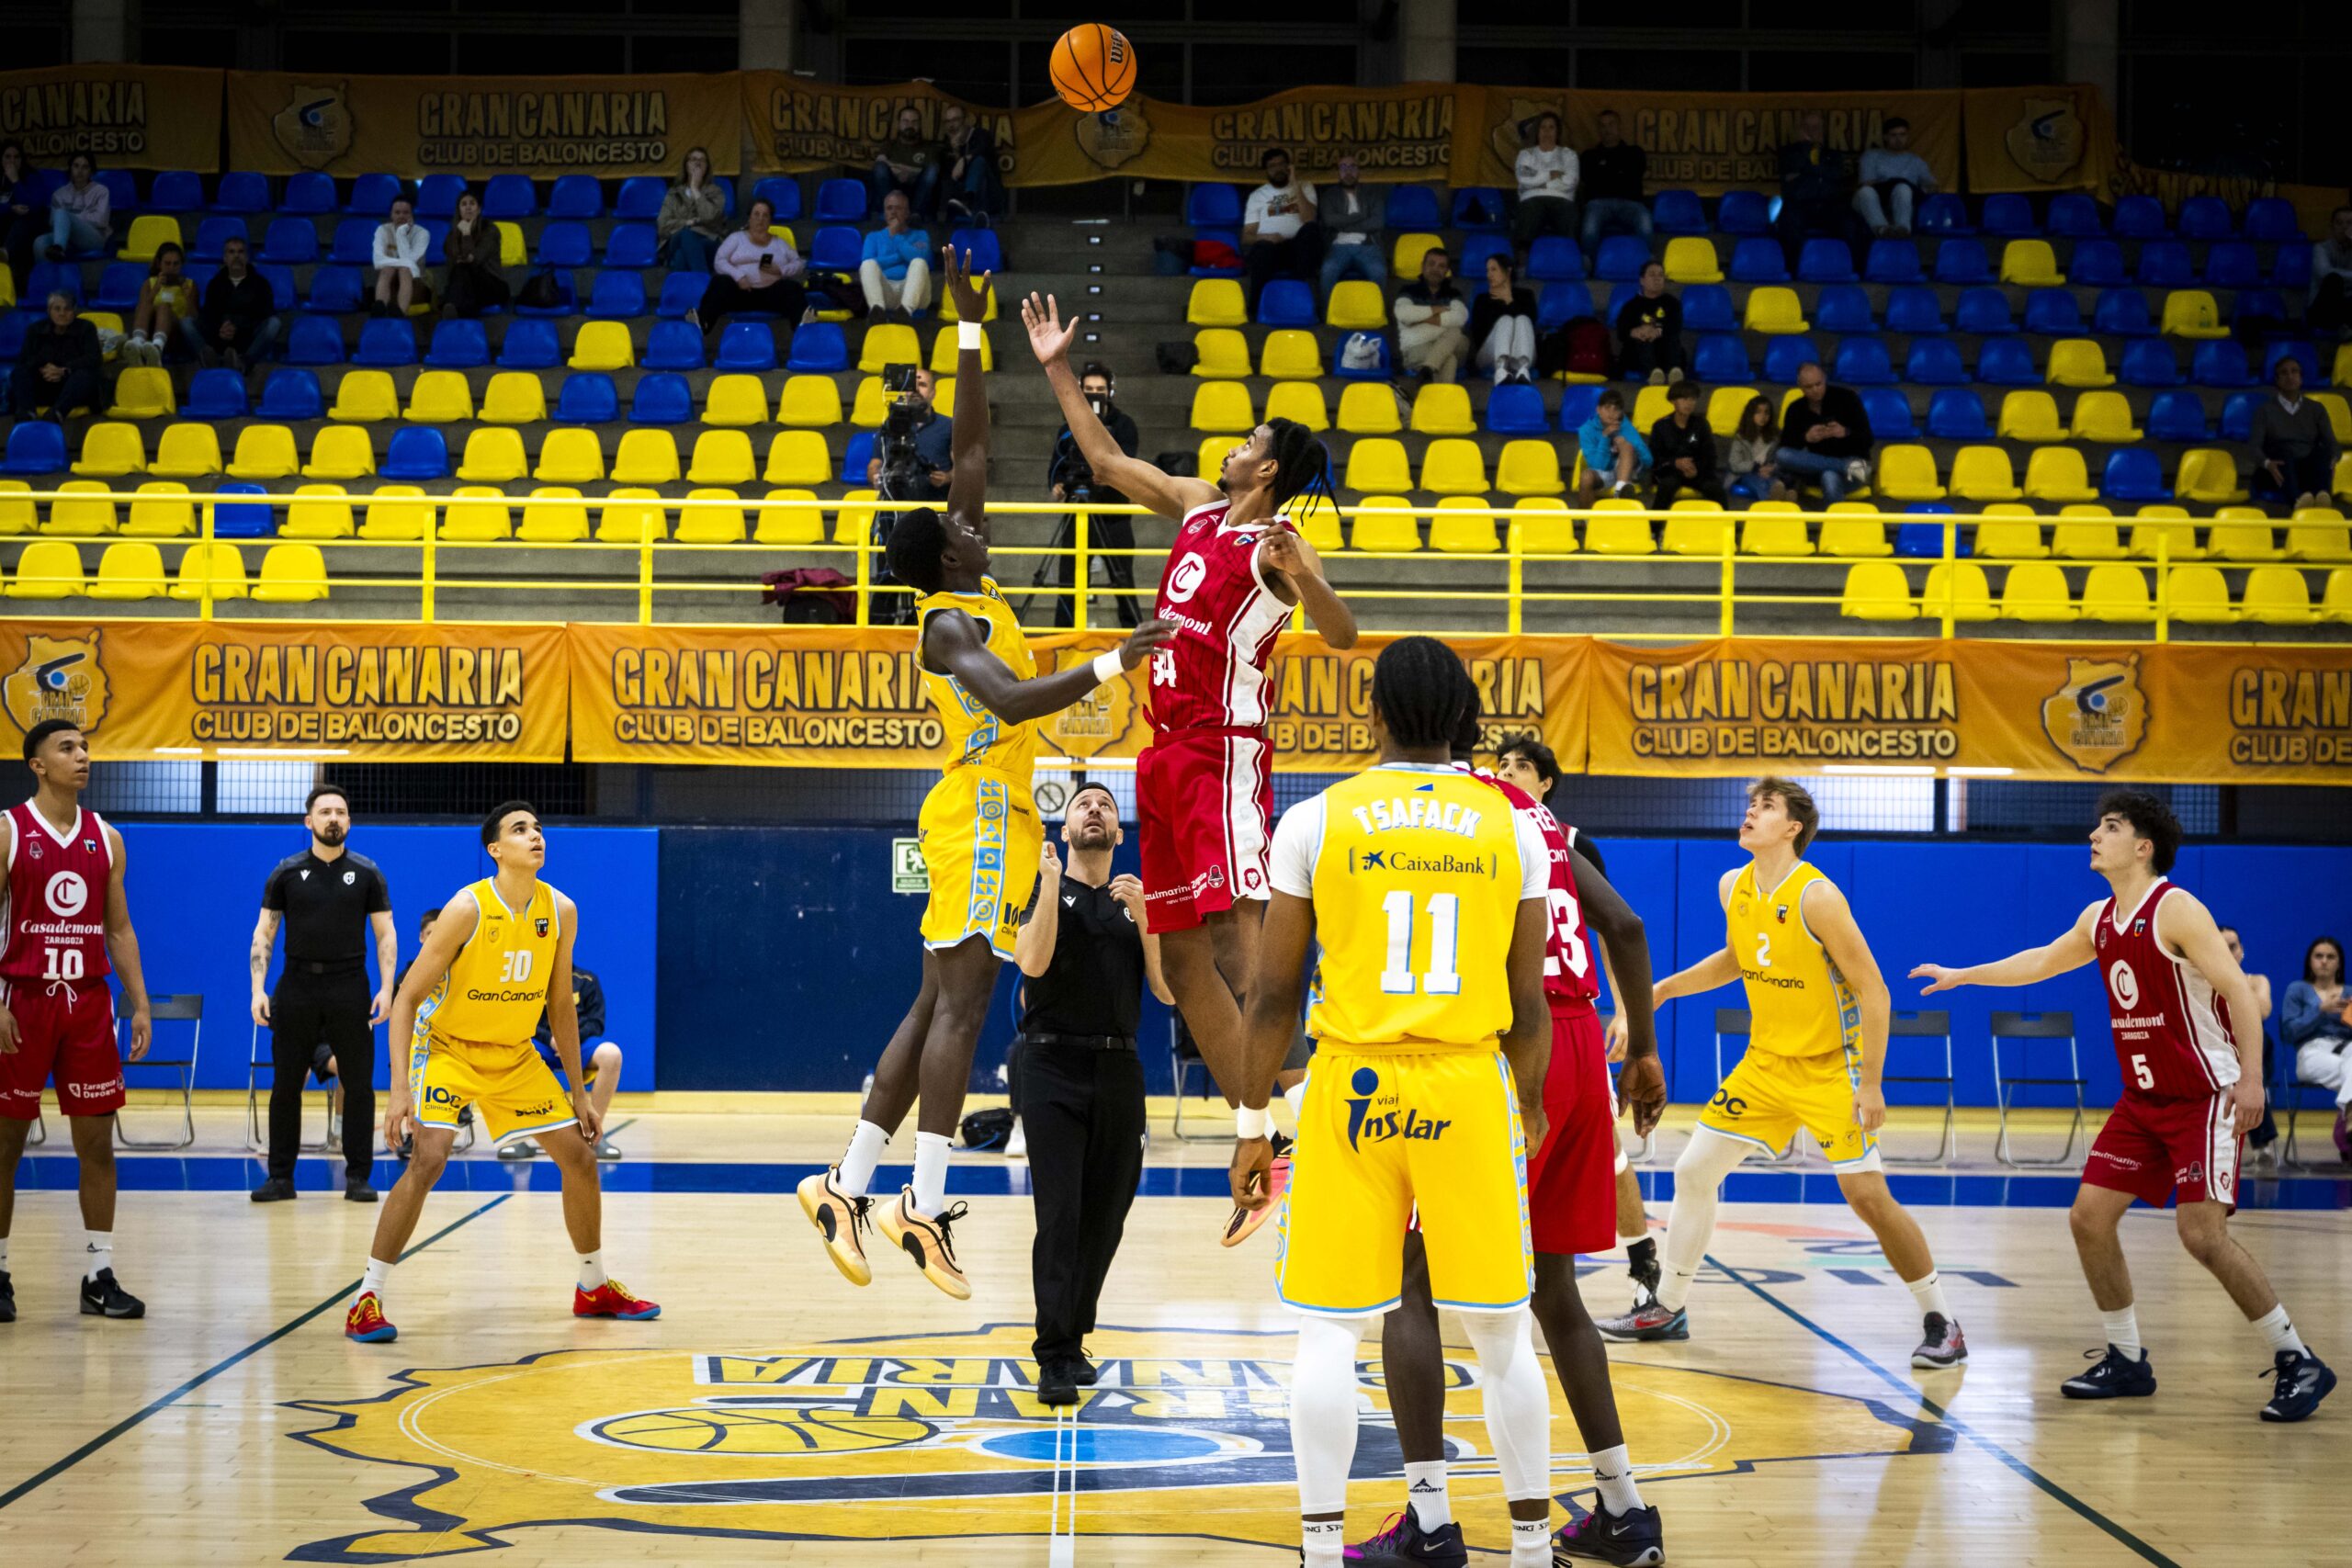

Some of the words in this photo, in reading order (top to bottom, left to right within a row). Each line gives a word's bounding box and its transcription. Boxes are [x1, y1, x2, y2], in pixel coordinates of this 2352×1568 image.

[2, 81, 145, 132] CANARIA
[420, 92, 510, 138] GRAN
[516, 91, 667, 138] CANARIA
[772, 89, 862, 139] GRAN
[1212, 101, 1306, 143] GRAN
[1311, 94, 1454, 144] CANARIA
[1635, 107, 1727, 154] GRAN
[419, 143, 478, 166] CLUB
[484, 144, 514, 164] DE
[518, 141, 667, 164] BALONCESTO
[1702, 159, 1733, 181] DE
[192, 644, 317, 705] GRAN
[324, 645, 523, 708] CANARIA
[613, 648, 736, 710] GRAN
[1153, 647, 1177, 687] 34
[1629, 660, 1751, 721] GRAN
[1758, 661, 1959, 723] CANARIA
[2231, 668, 2352, 730] GRAN
[192, 709, 274, 742] CLUB
[277, 711, 320, 742] DE
[323, 711, 523, 743] BALONCESTO
[615, 713, 694, 745] CLUB
[699, 715, 740, 746] DE
[745, 715, 944, 749] BALONCESTO
[1302, 722, 1344, 752] DE
[1633, 726, 1711, 758] CLUB
[1716, 727, 1758, 759] DE
[1762, 728, 1959, 761] BALONCESTO
[2232, 734, 2309, 764] CLUB
[2313, 736, 2352, 765] DE
[1352, 797, 1482, 840] TSAFACK
[1390, 852, 1485, 875] CaixaBank
[20, 919, 103, 934] Casademon
[44, 936, 84, 945] ZARAGOZA
[1380, 890, 1461, 995] 11
[42, 947, 85, 980] 10
[500, 950, 533, 983] 30
[1757, 932, 1771, 966] 2
[1742, 969, 1758, 981] ran
[2111, 1012, 2165, 1030] asademont
[2132, 1054, 2154, 1090] 5
[1713, 1089, 1747, 1115] OC
